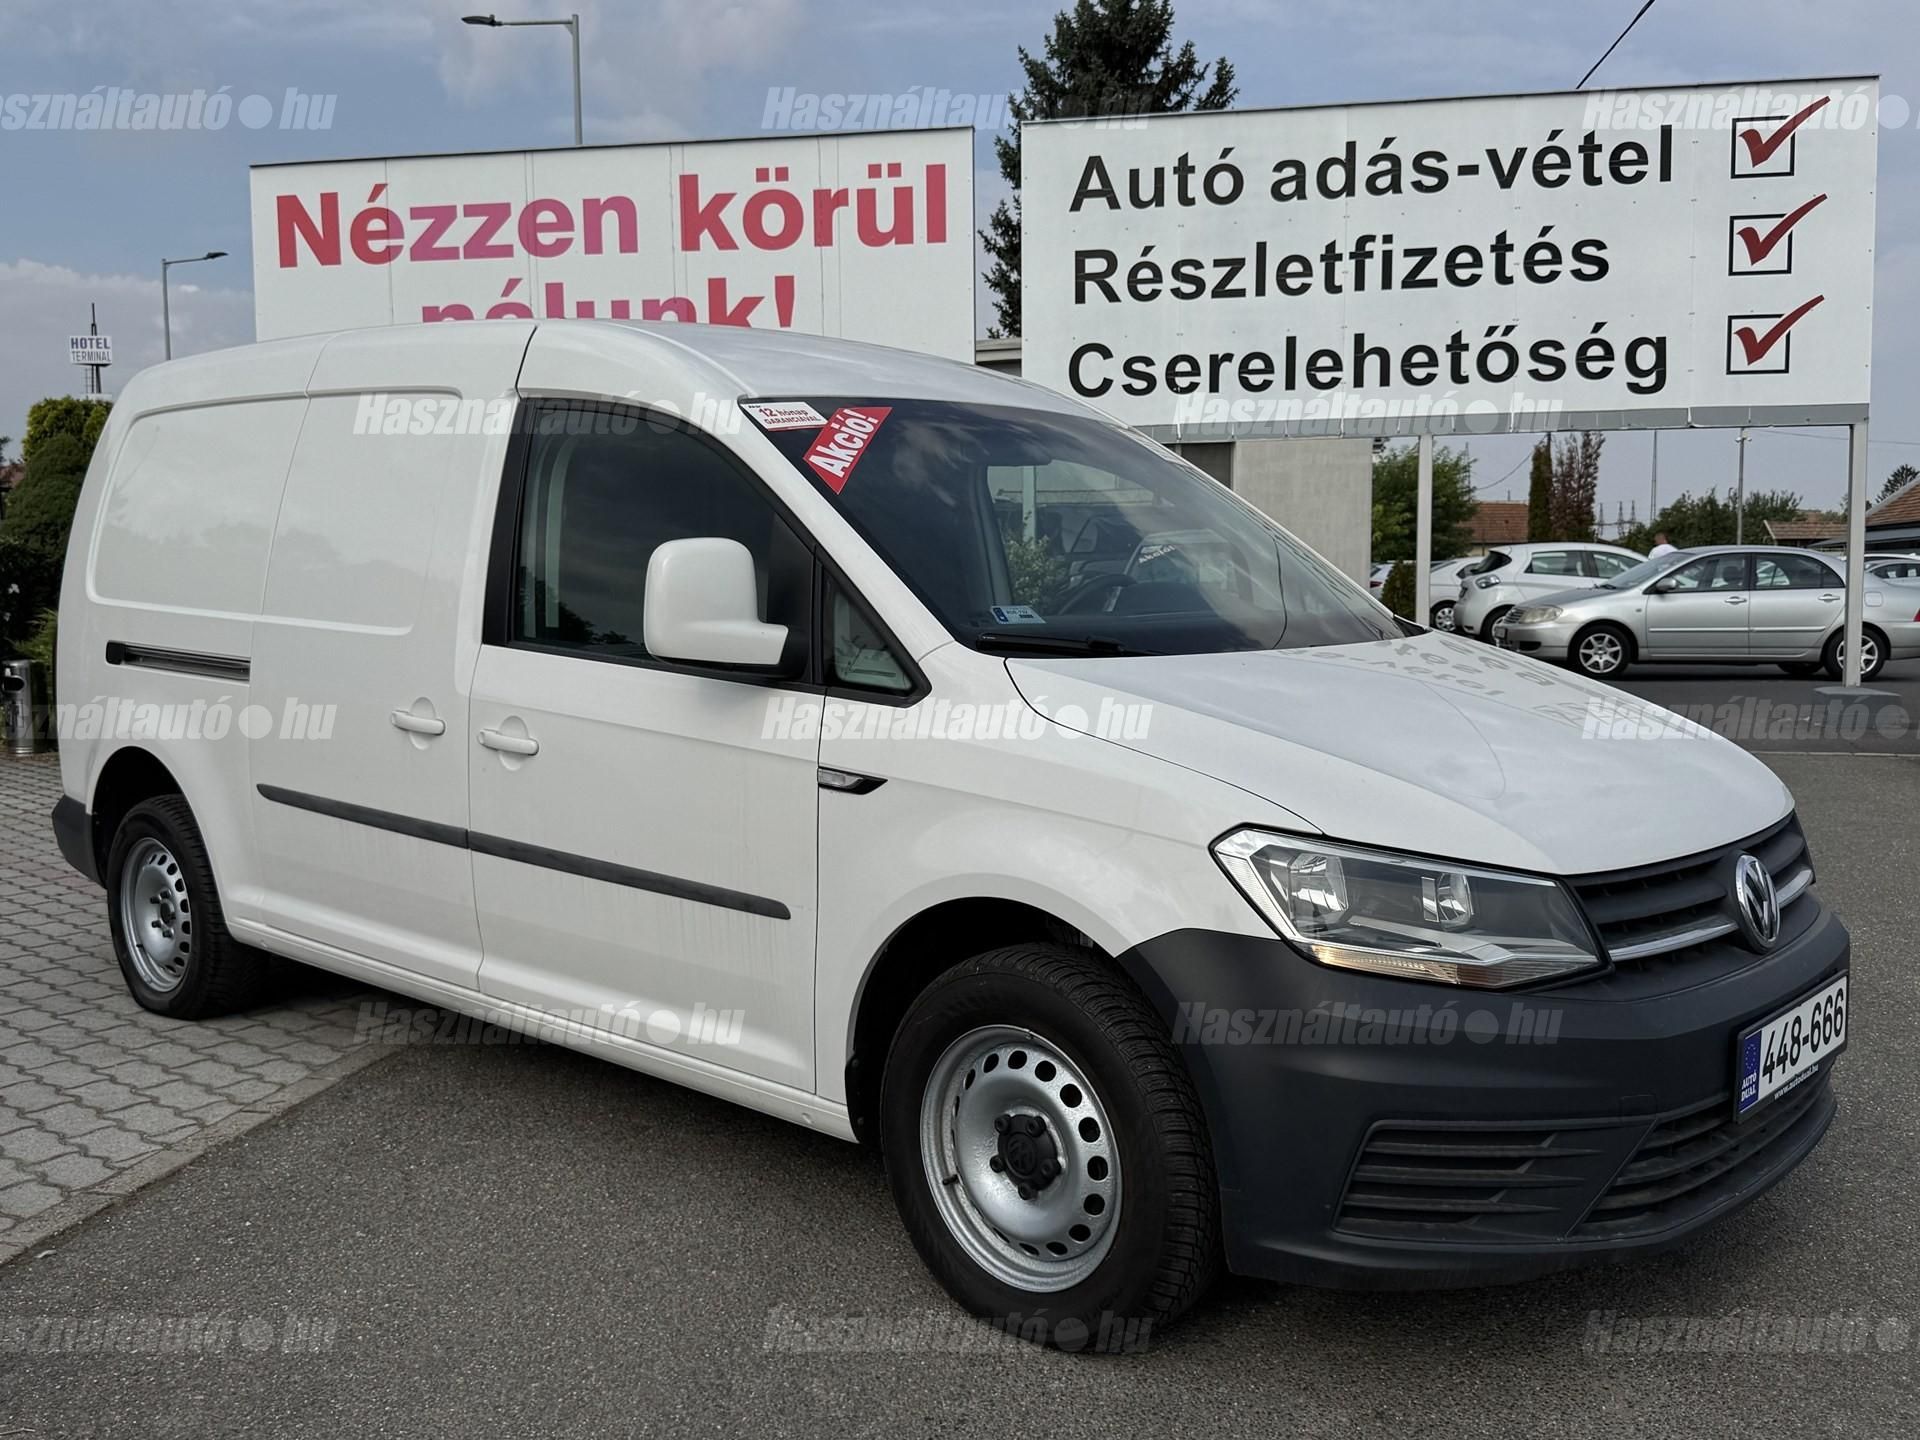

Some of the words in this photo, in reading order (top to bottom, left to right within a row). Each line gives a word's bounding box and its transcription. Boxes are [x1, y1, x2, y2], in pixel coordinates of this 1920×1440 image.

[1069, 147, 1245, 213] Autó
[1270, 124, 1673, 202] adás-vétel
[276, 183, 639, 269] Nézzen
[679, 163, 948, 252] körül
[1074, 225, 1610, 305] Részletfizetés
[71, 337, 111, 350] HOTEL
[72, 351, 111, 362] TERMINAL
[1068, 321, 1668, 398] Cserelehetőség
[759, 407, 777, 418] 12
[808, 408, 880, 479] Akció!
[1762, 987, 1844, 1084] 448-666
